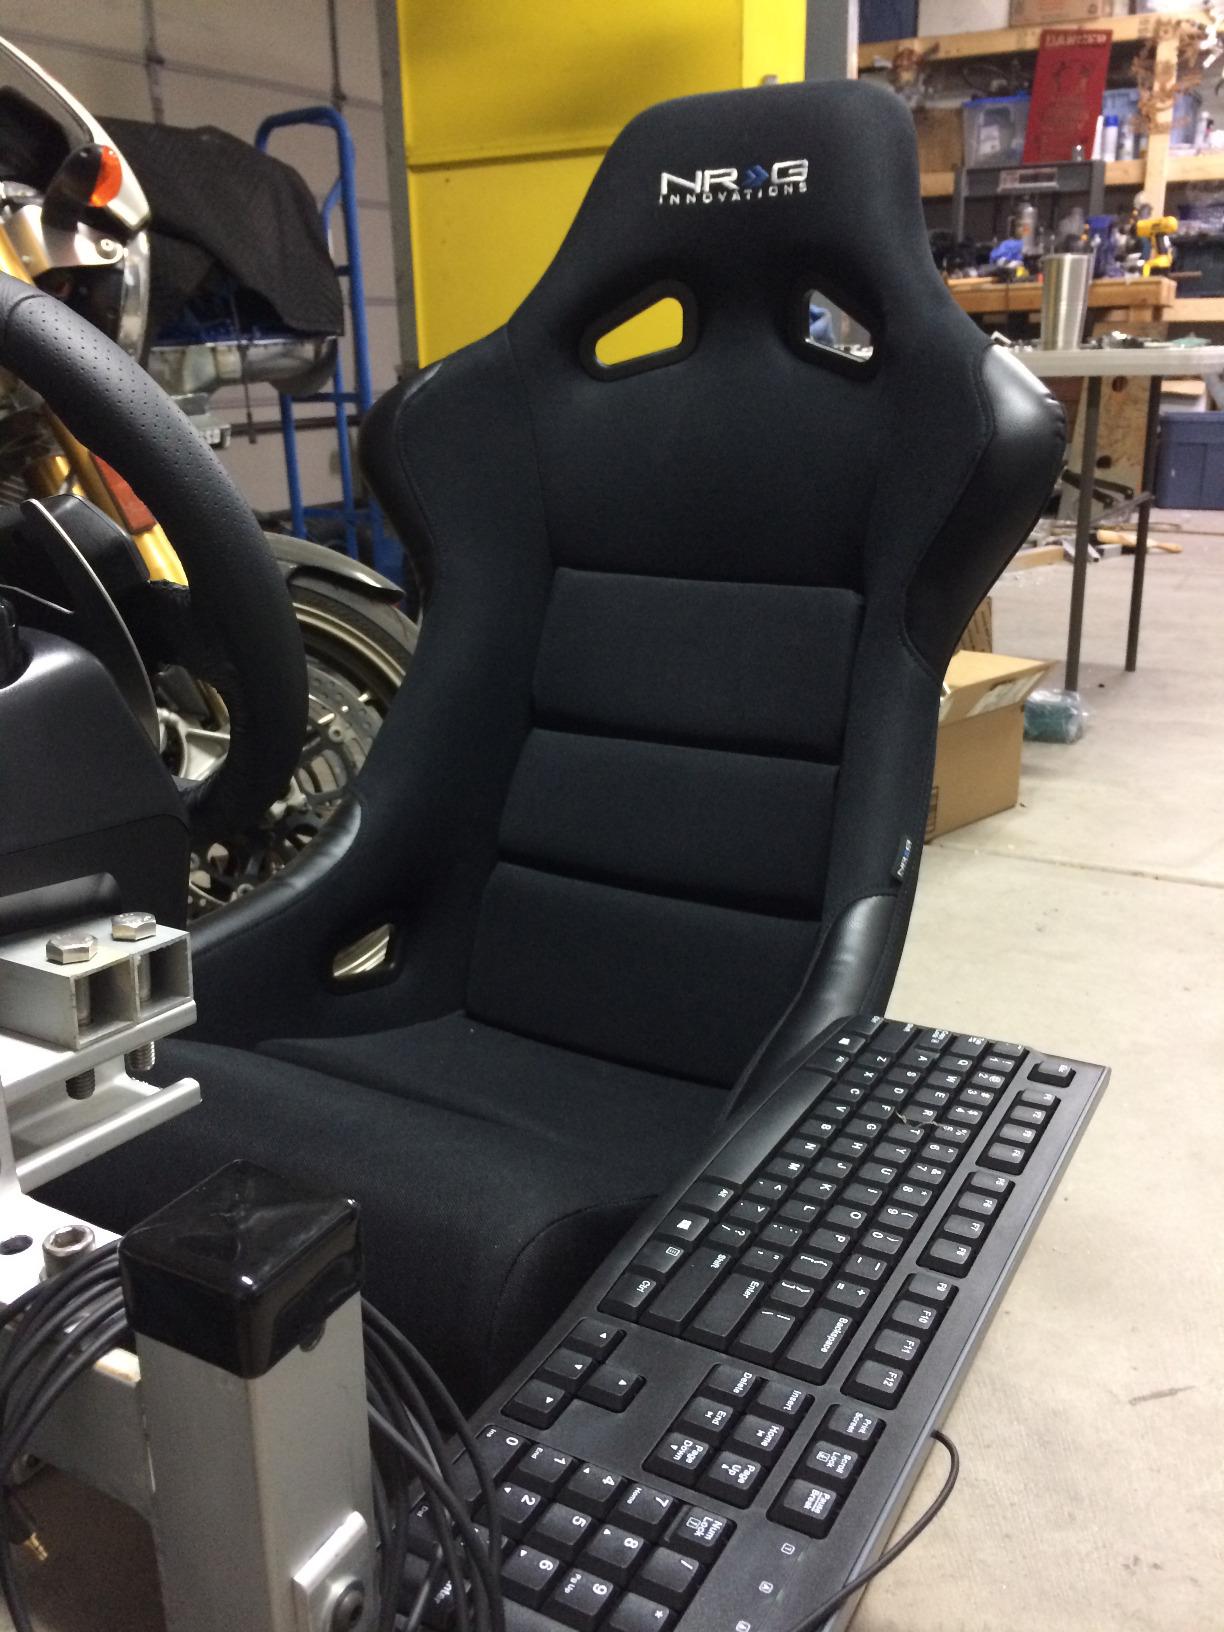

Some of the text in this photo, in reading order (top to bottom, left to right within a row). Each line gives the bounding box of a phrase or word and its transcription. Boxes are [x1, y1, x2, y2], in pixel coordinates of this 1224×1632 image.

[659, 182, 808, 205] INNOVATIONS
[804, 1142, 817, 1151] N
[851, 1142, 863, 1150] H
[788, 1162, 801, 1171] M
[880, 1167, 893, 1176] U
[819, 1183, 832, 1191] K
[902, 1185, 914, 1193] 8
[850, 1211, 862, 1220] O
[970, 1222, 980, 1232] F7
[835, 1234, 846, 1243] P
[710, 1254, 727, 1269] Shift
[636, 1280, 651, 1293] Ctrl
[742, 1280, 760, 1299] Enter
[936, 1282, 948, 1292] F9
[918, 1309, 932, 1324] F10
[820, 1317, 849, 1353] Backspace
[901, 1340, 915, 1354] F11
[733, 1371, 753, 1394] Delete
[883, 1371, 898, 1387] F12
[783, 1389, 802, 1411] Insert
[711, 1410, 727, 1426] End
[846, 1411, 864, 1433] Screen
[486, 1428, 497, 1438] Ins
[858, 1418, 872, 1434] Print
[505, 1436, 519, 1446] 0
[760, 1425, 780, 1447] Home
[531, 1447, 544, 1460] End
[673, 1439, 693, 1461] Down
[685, 1444, 704, 1464] Page
[553, 1457, 566, 1465] 1
[826, 1451, 841, 1468] Lock
[835, 1454, 852, 1474] Scroll
[728, 1464, 742, 1476] Up
[737, 1464, 756, 1484] Page
[602, 1475, 615, 1486] 4
[520, 1494, 536, 1506] 2
[626, 1487, 642, 1505] Home
[655, 1496, 670, 1508] 7
[803, 1488, 821, 1510] Break
[814, 1492, 831, 1514] Pause
[572, 1515, 587, 1528] 5
[694, 1516, 714, 1537] Lock
[704, 1520, 723, 1540] Num
[623, 1537, 639, 1549] 8
[539, 1560, 554, 1571] 6
[434, 1580, 452, 1604] nter
[592, 1583, 608, 1595] 9
